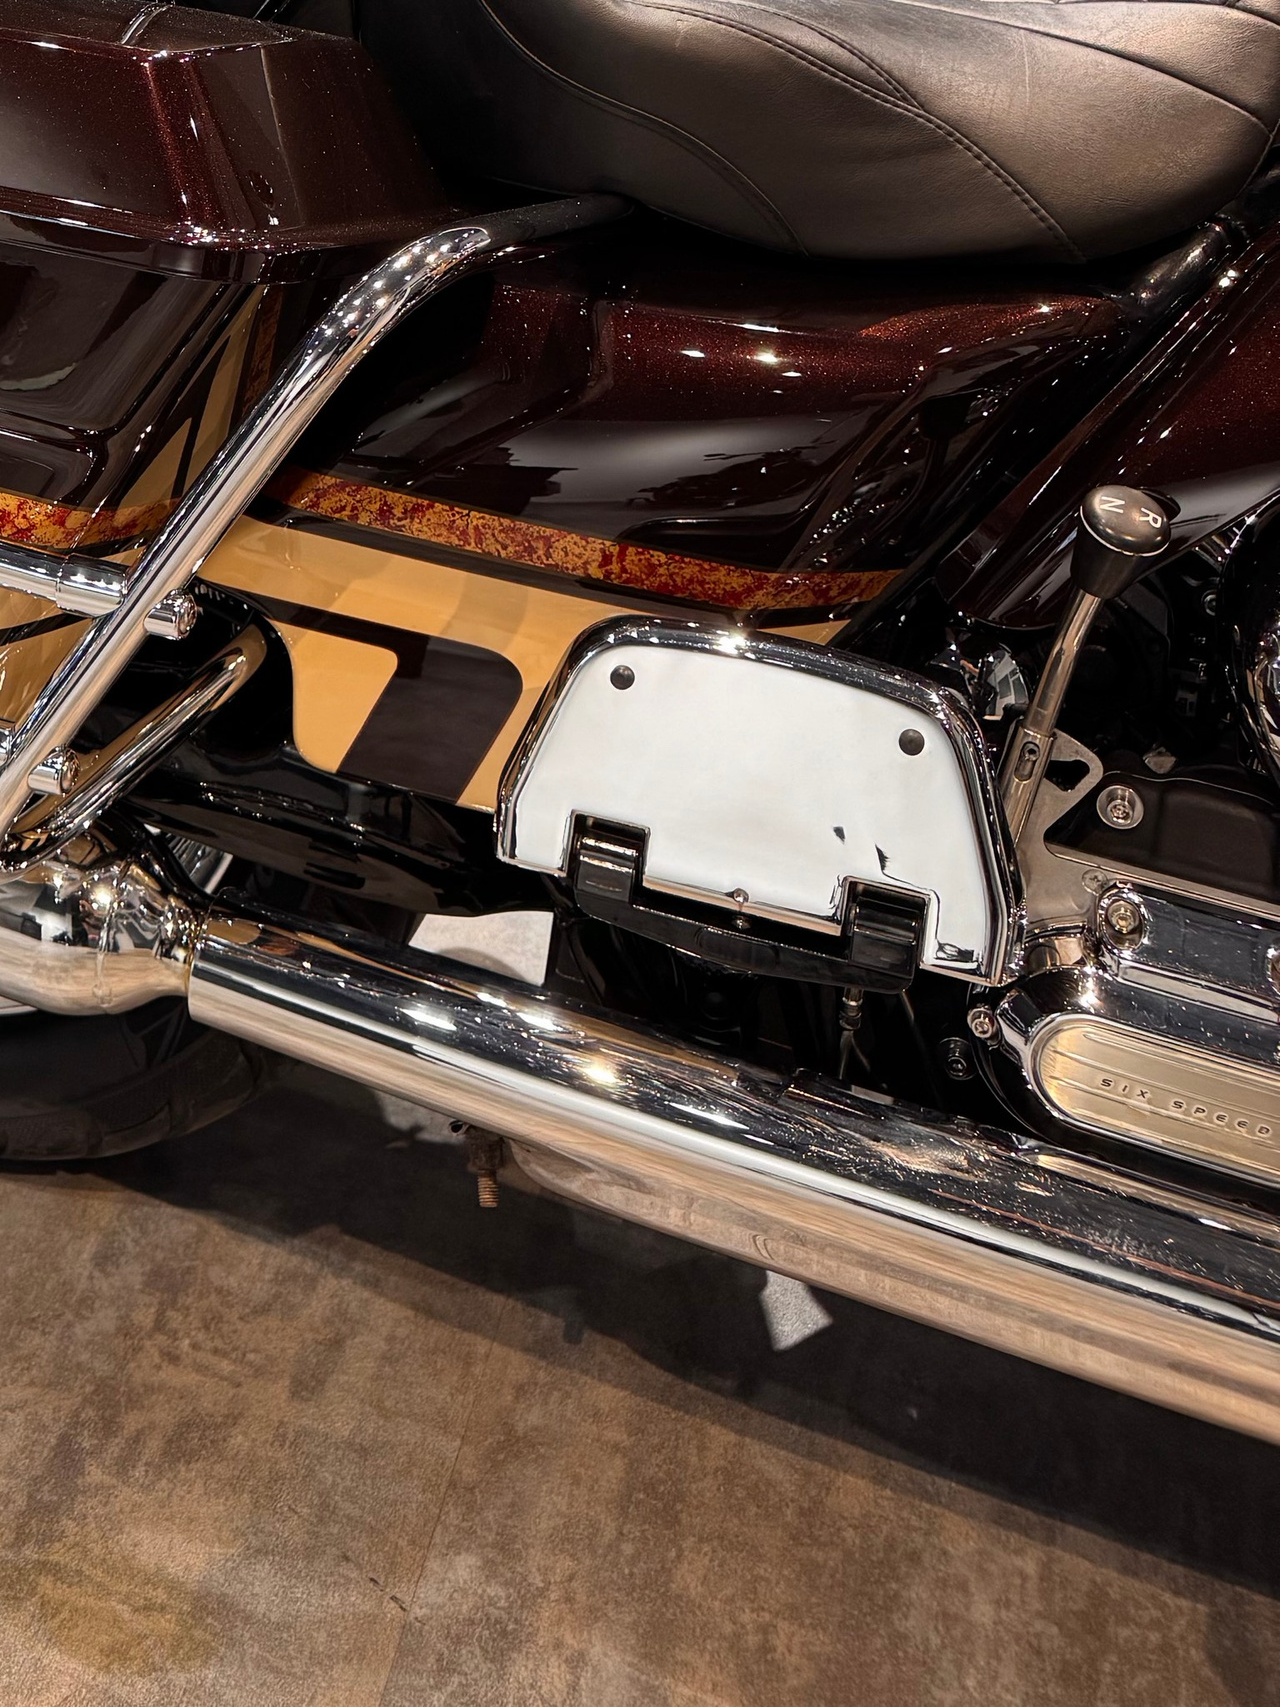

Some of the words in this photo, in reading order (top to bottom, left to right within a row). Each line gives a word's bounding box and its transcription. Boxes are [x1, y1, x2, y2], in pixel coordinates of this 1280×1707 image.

[1100, 496, 1126, 514] N
[1139, 507, 1162, 529] R
[1100, 1078, 1149, 1100] SIX
[1171, 1100, 1271, 1136] SPEED
